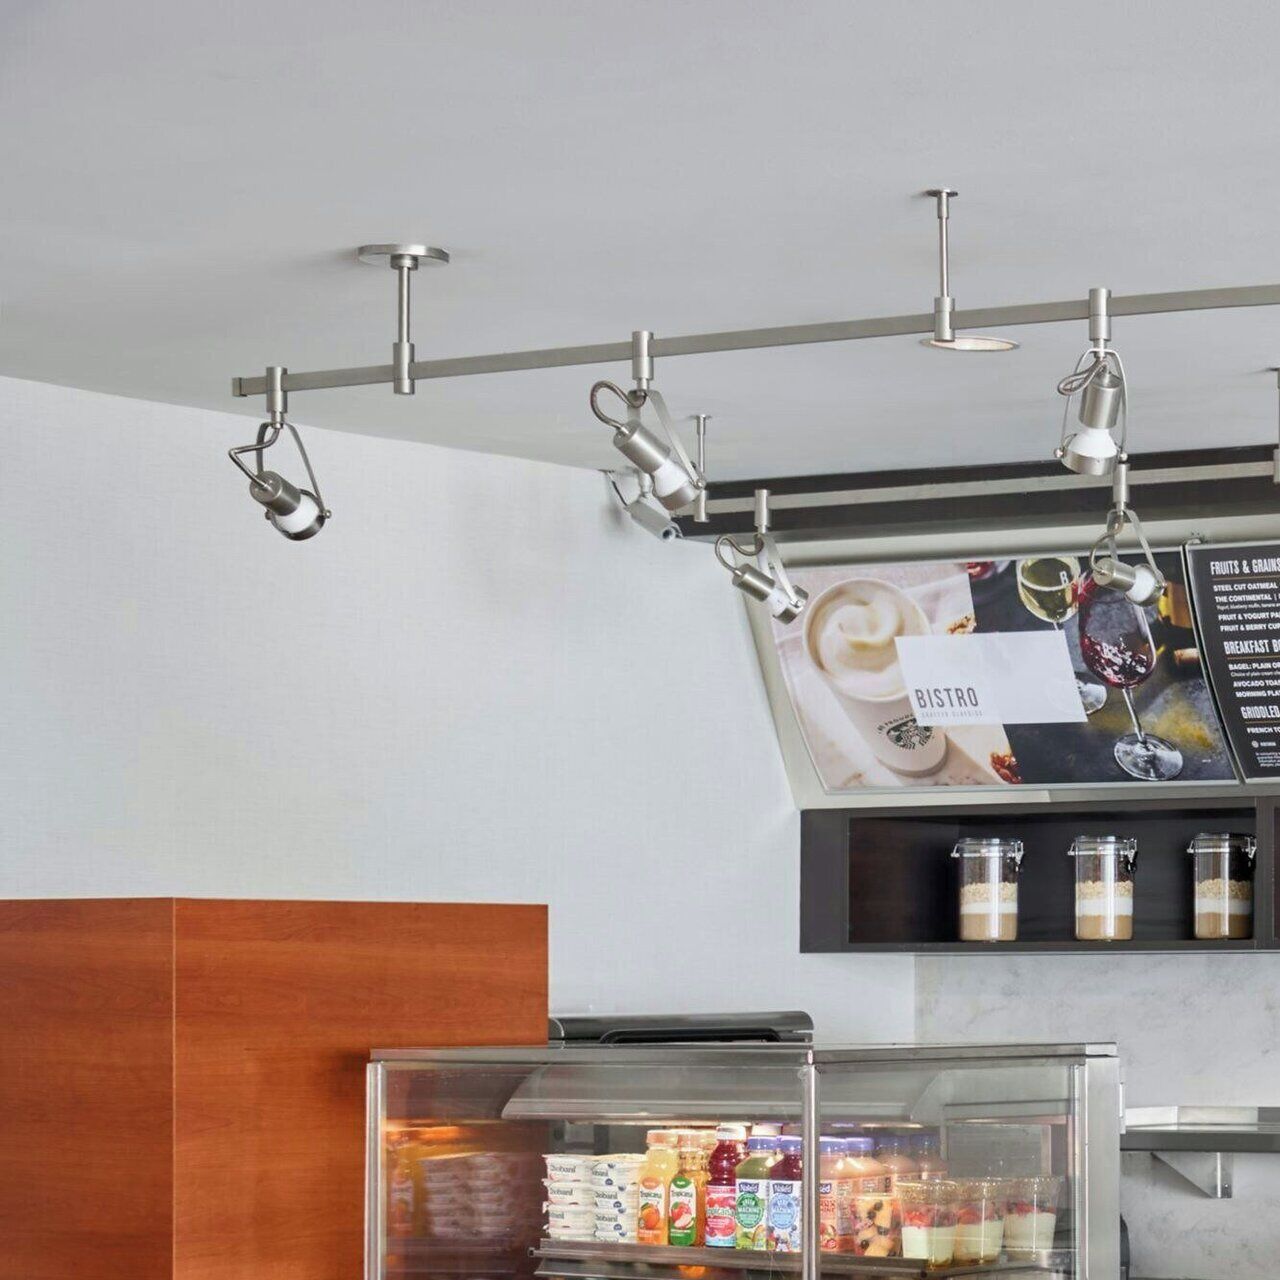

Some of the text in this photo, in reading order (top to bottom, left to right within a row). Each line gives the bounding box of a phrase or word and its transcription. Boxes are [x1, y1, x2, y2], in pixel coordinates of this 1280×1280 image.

[1210, 560, 1239, 576] FRUITS
[1242, 561, 1251, 574] &
[1223, 639, 1270, 655] BREAKFAST
[915, 687, 979, 708] BISTRO
[1240, 705, 1280, 719] GRIDDLED
